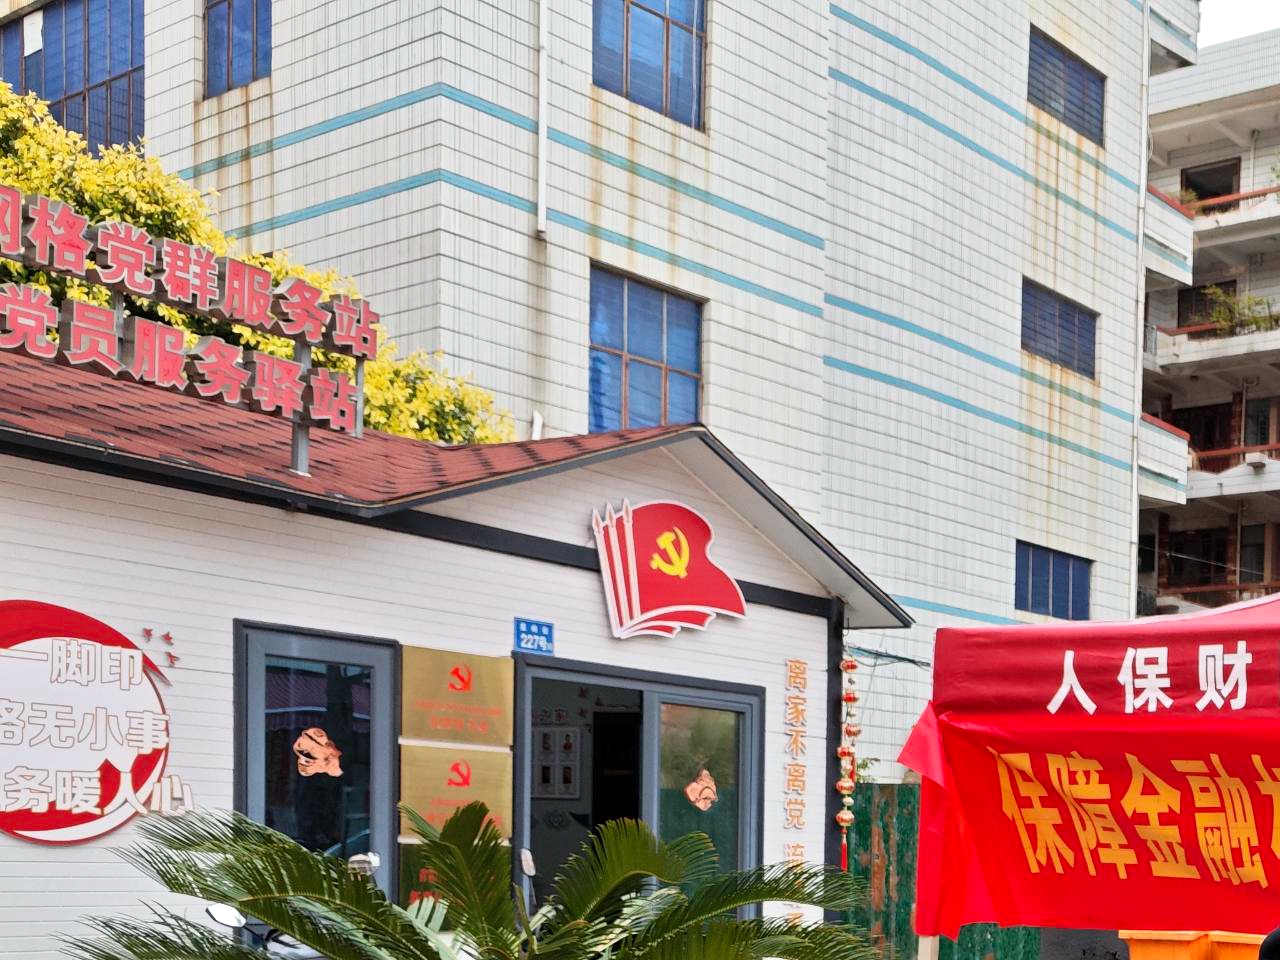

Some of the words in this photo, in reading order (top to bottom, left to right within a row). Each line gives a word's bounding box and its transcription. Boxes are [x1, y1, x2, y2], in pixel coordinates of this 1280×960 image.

[0, 283, 358, 432] 党员服务驿站
[4, 766, 195, 816] 务暖人心
